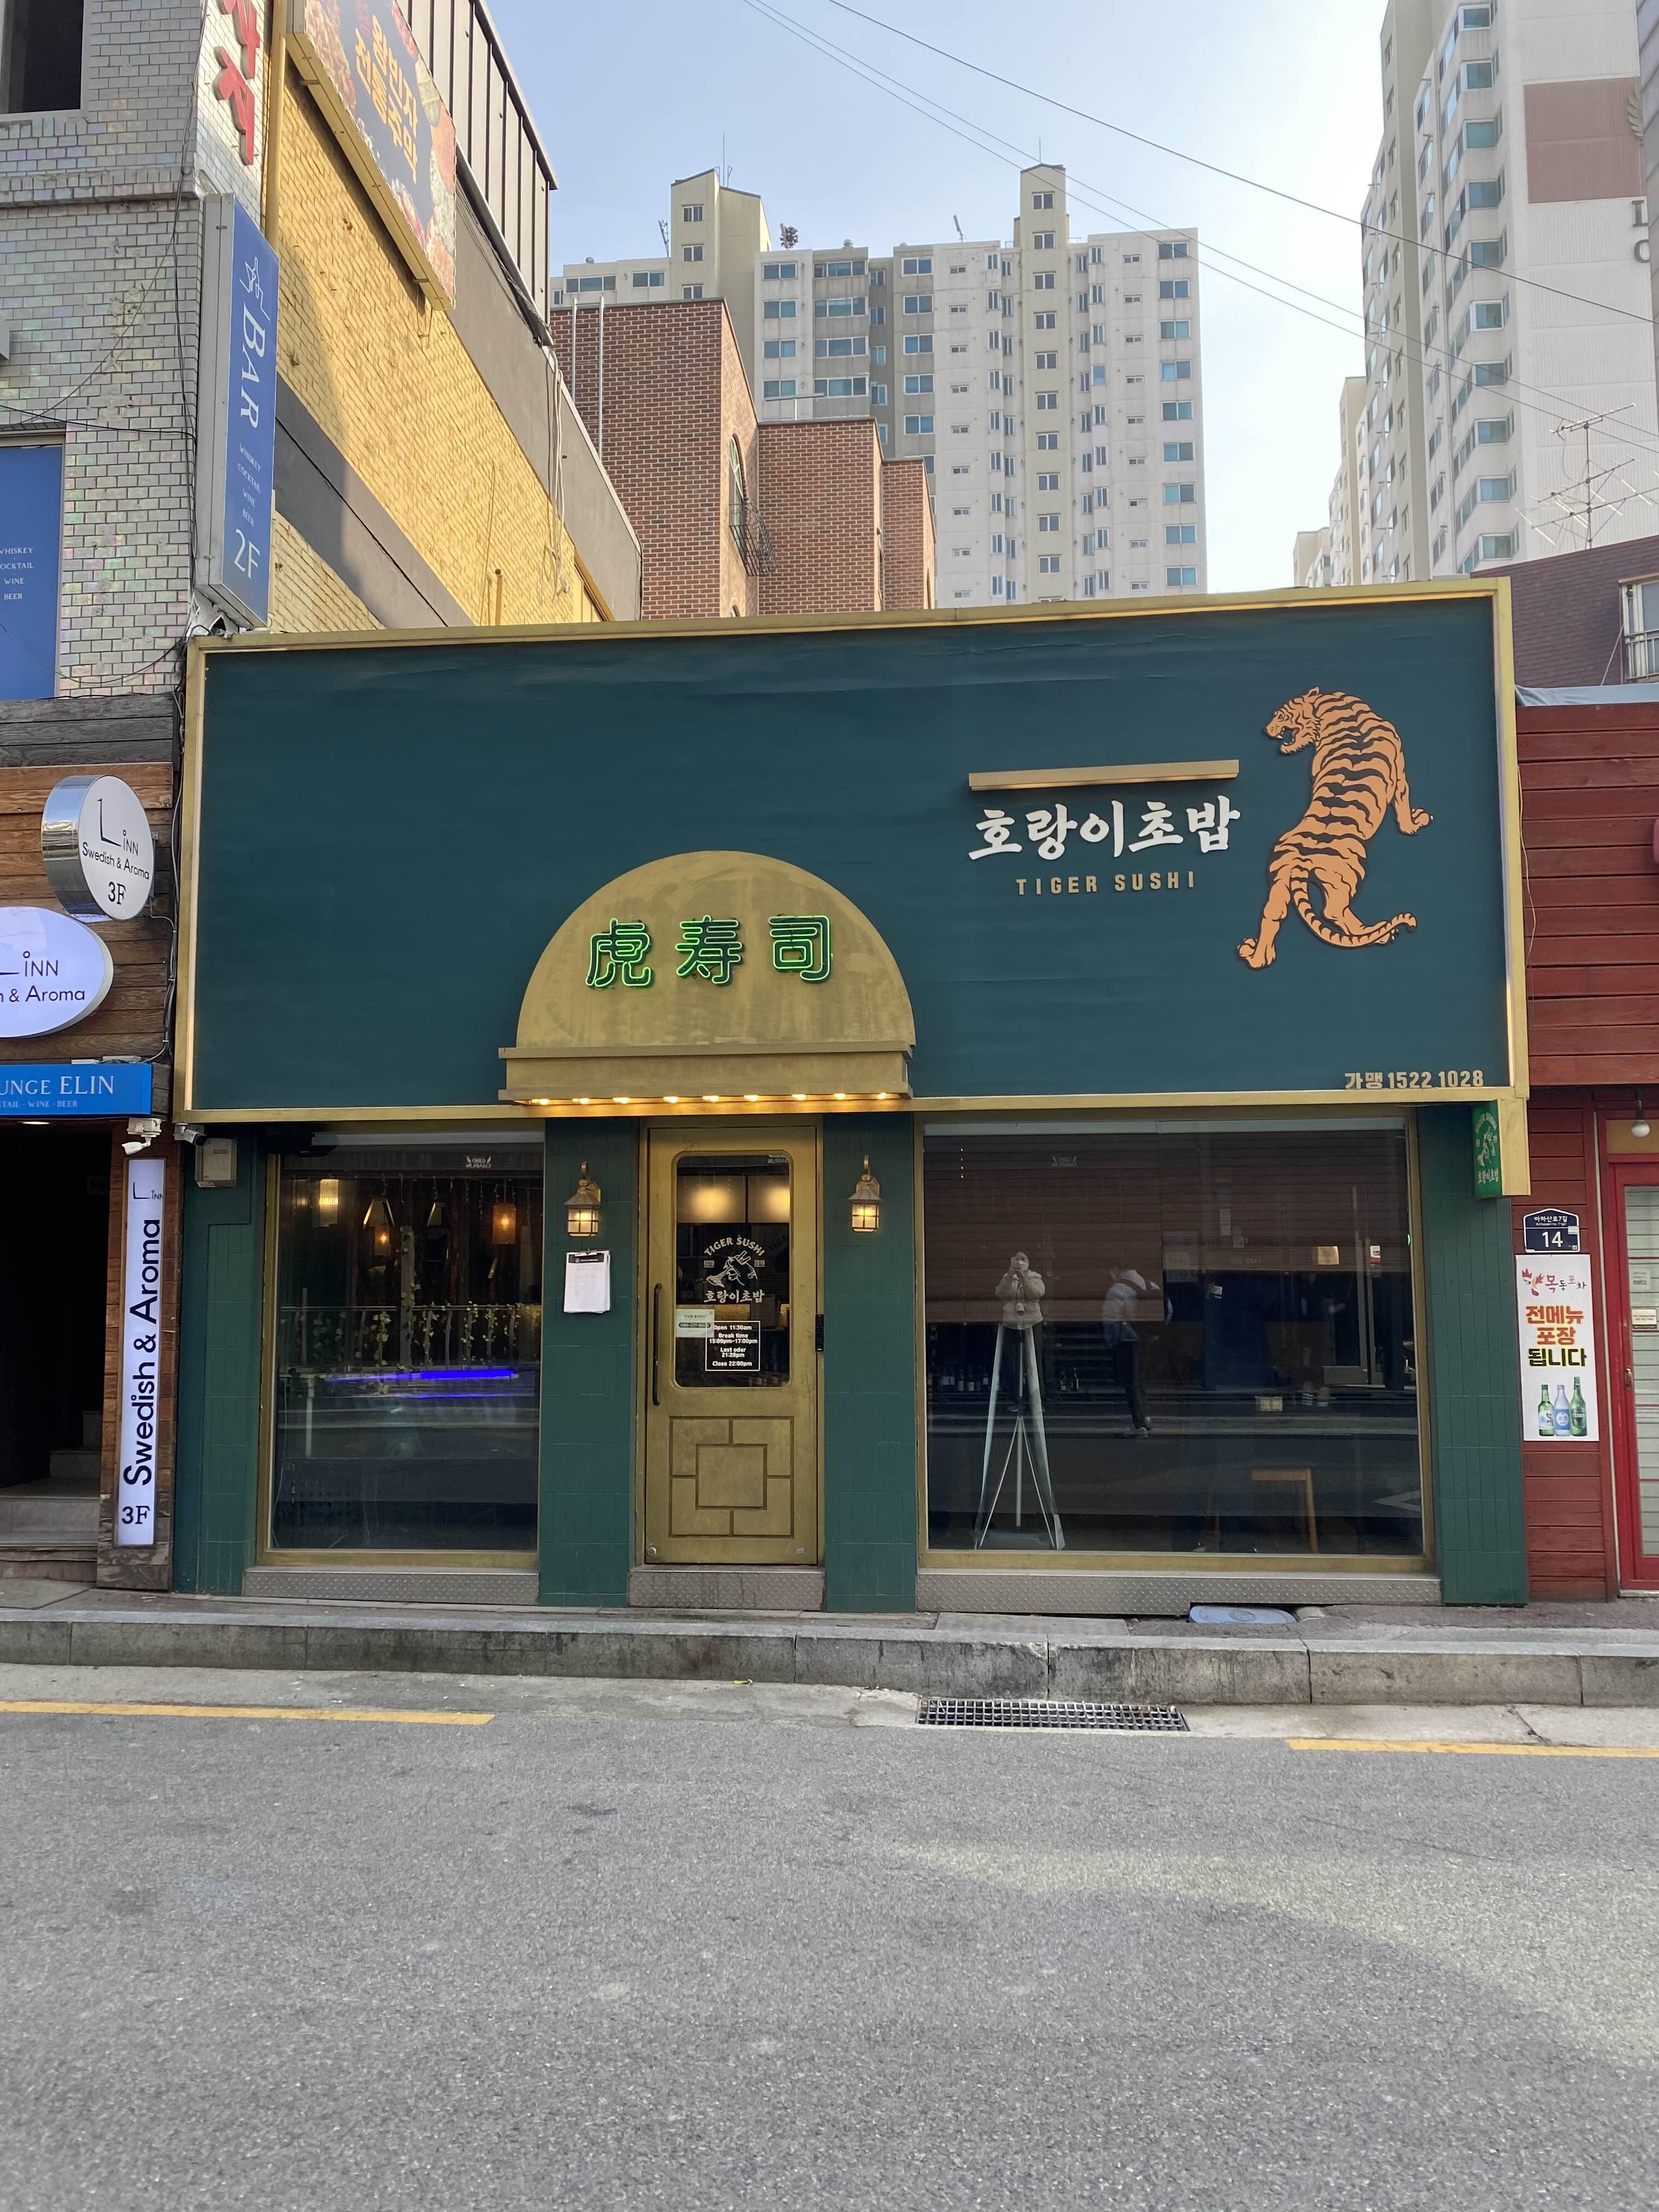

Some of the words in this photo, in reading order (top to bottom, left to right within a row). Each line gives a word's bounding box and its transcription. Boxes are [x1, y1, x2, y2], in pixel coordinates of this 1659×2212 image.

[240, 302, 266, 428] BAR
[239, 443, 261, 472] WHISKEY
[238, 462, 262, 493] COCKTAIL
[242, 487, 256, 507] WINE
[242, 509, 255, 527] BEER
[234, 528, 261, 579] 2F
[968, 795, 1240, 860] 호랑이초밥
[82, 842, 115, 867] Swedish
[116, 857, 122, 869] &
[123, 859, 149, 879] Aroma
[1016, 876, 1097, 895] TIGER
[1115, 871, 1194, 891] SUSHI
[108, 882, 126, 905] 3F
[585, 915, 831, 988] 虎寿司
[9, 989, 19, 1002] &
[25, 985, 85, 1002] Aroma
[59, 1076, 114, 1094] ELIN
[1345, 1072, 1383, 1089] 가맹
[1387, 1071, 1432, 1088] 1522
[1438, 1070, 1484, 1088] 1028
[704, 1238, 733, 1256] TIGER
[736, 1237, 765, 1256] SUSHI
[1542, 1231, 1564, 1247] 14
[130, 1220, 160, 1324] Aroma
[704, 1290, 765, 1303] 호랑이초밥
[1526, 1305, 1584, 1324] 전메뉴
[133, 1334, 156, 1353] &
[1537, 1327, 1576, 1345] 포장
[1528, 1348, 1587, 1367] 됩니다
[123, 1363, 155, 1486] Swedish
[122, 1506, 150, 1524] 3F
